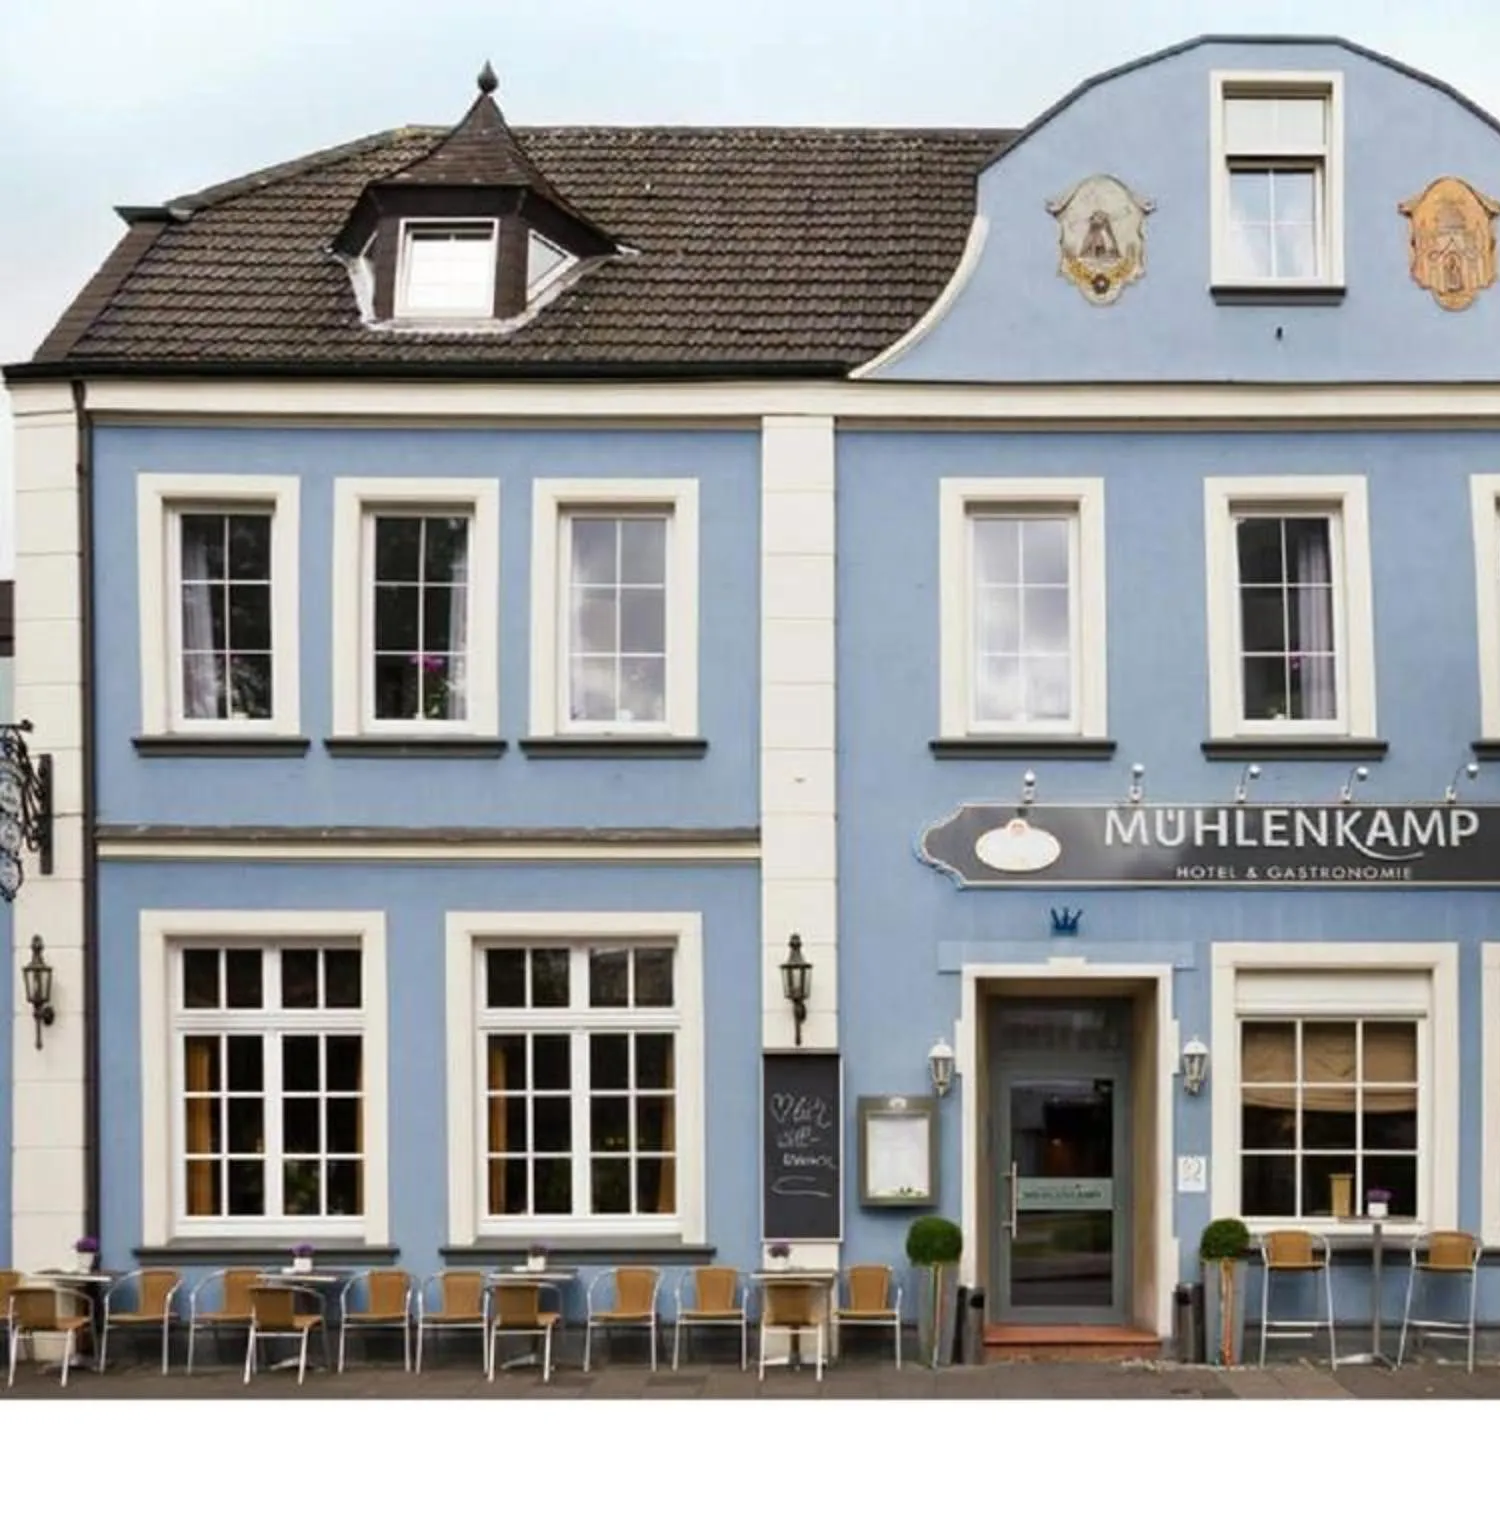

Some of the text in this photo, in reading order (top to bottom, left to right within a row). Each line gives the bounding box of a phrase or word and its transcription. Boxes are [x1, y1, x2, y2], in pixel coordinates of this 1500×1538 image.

[1104, 808, 1480, 861] MÜHLENKAMP
[1175, 865, 1413, 881] HOTEL & GASTRONOMIE
